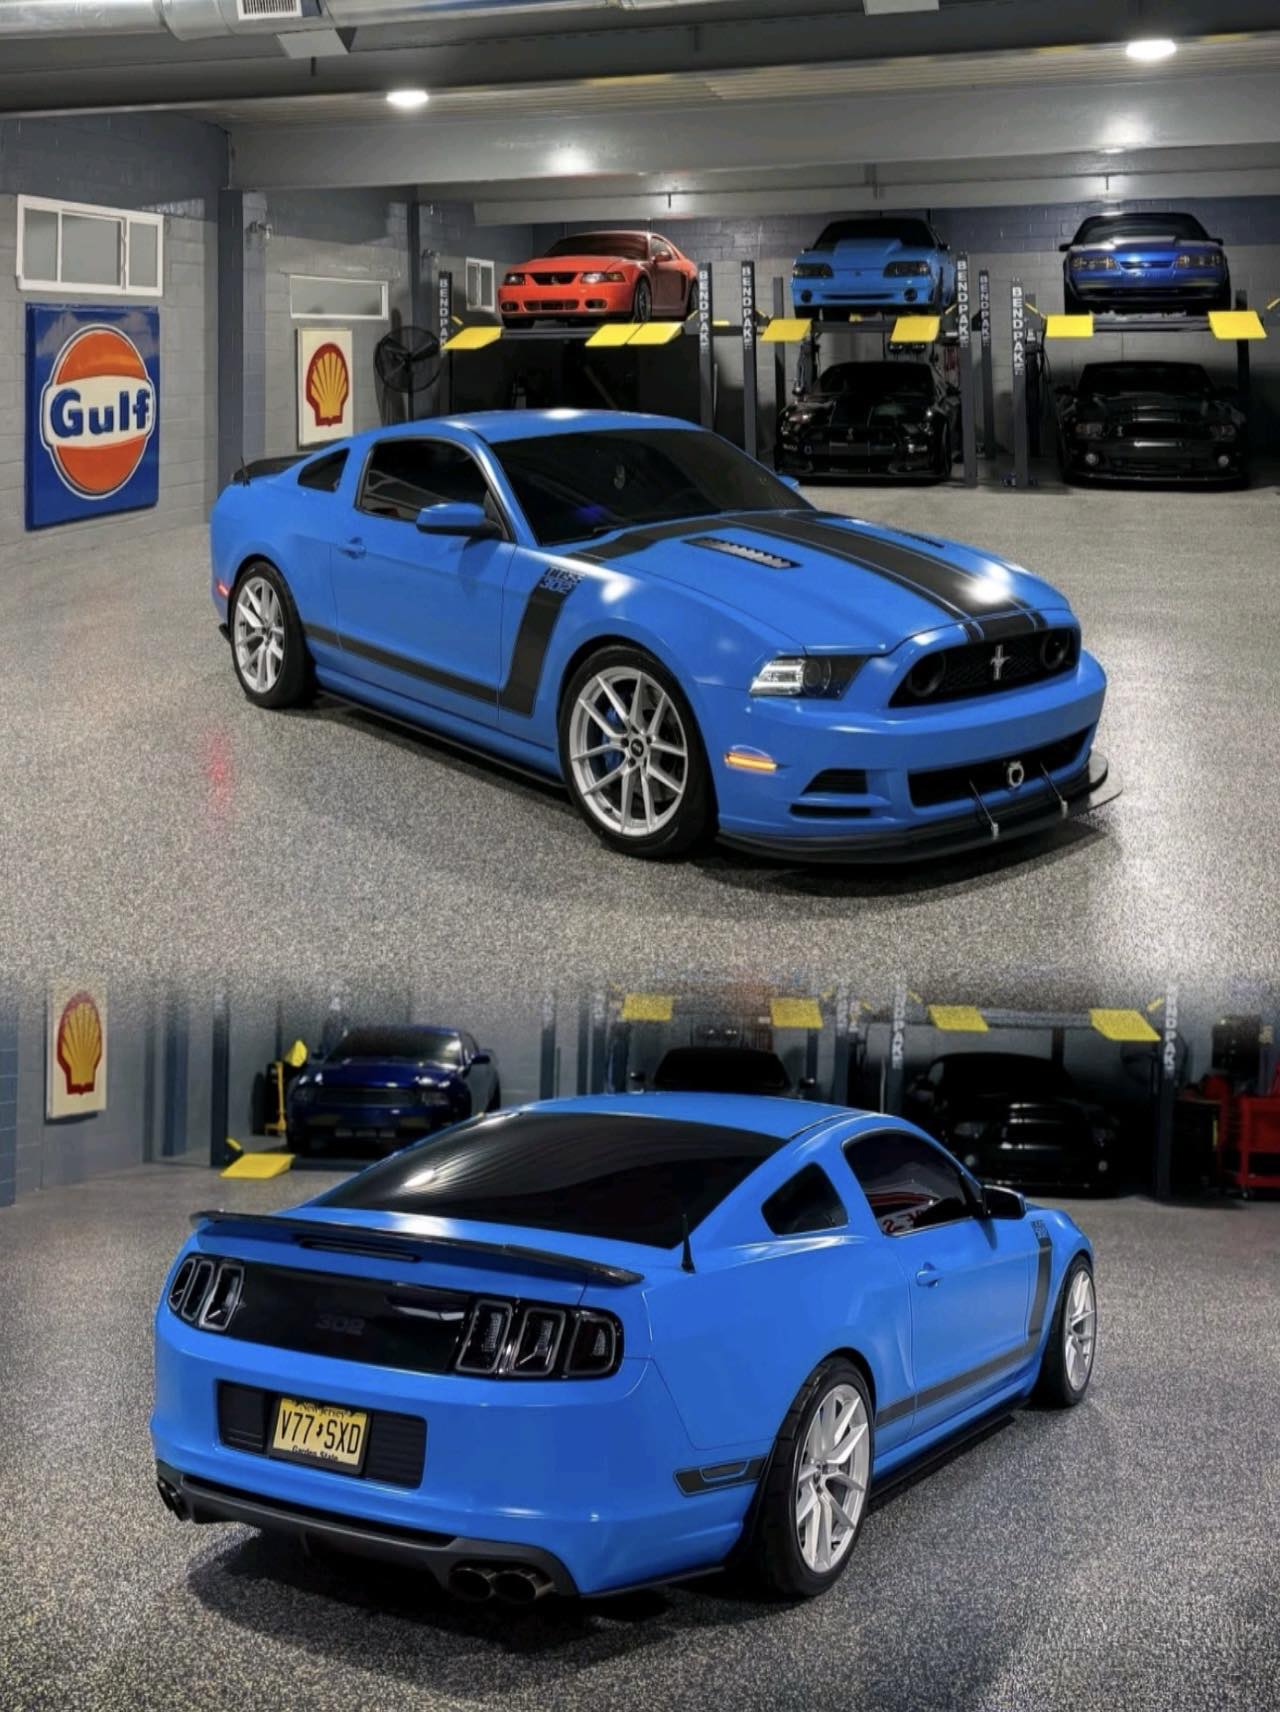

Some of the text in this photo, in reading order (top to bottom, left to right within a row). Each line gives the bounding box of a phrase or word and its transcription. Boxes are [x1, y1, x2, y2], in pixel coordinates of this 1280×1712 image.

[699, 270, 709, 341] BENDPAK
[742, 266, 752, 338] BENDPAK
[957, 261, 969, 338] BENDPAK
[980, 276, 990, 339] BENDPAK
[1012, 287, 1024, 363] BENDPAK
[50, 388, 151, 438] Gulf
[281, 1410, 361, 1454] V77 SXD
